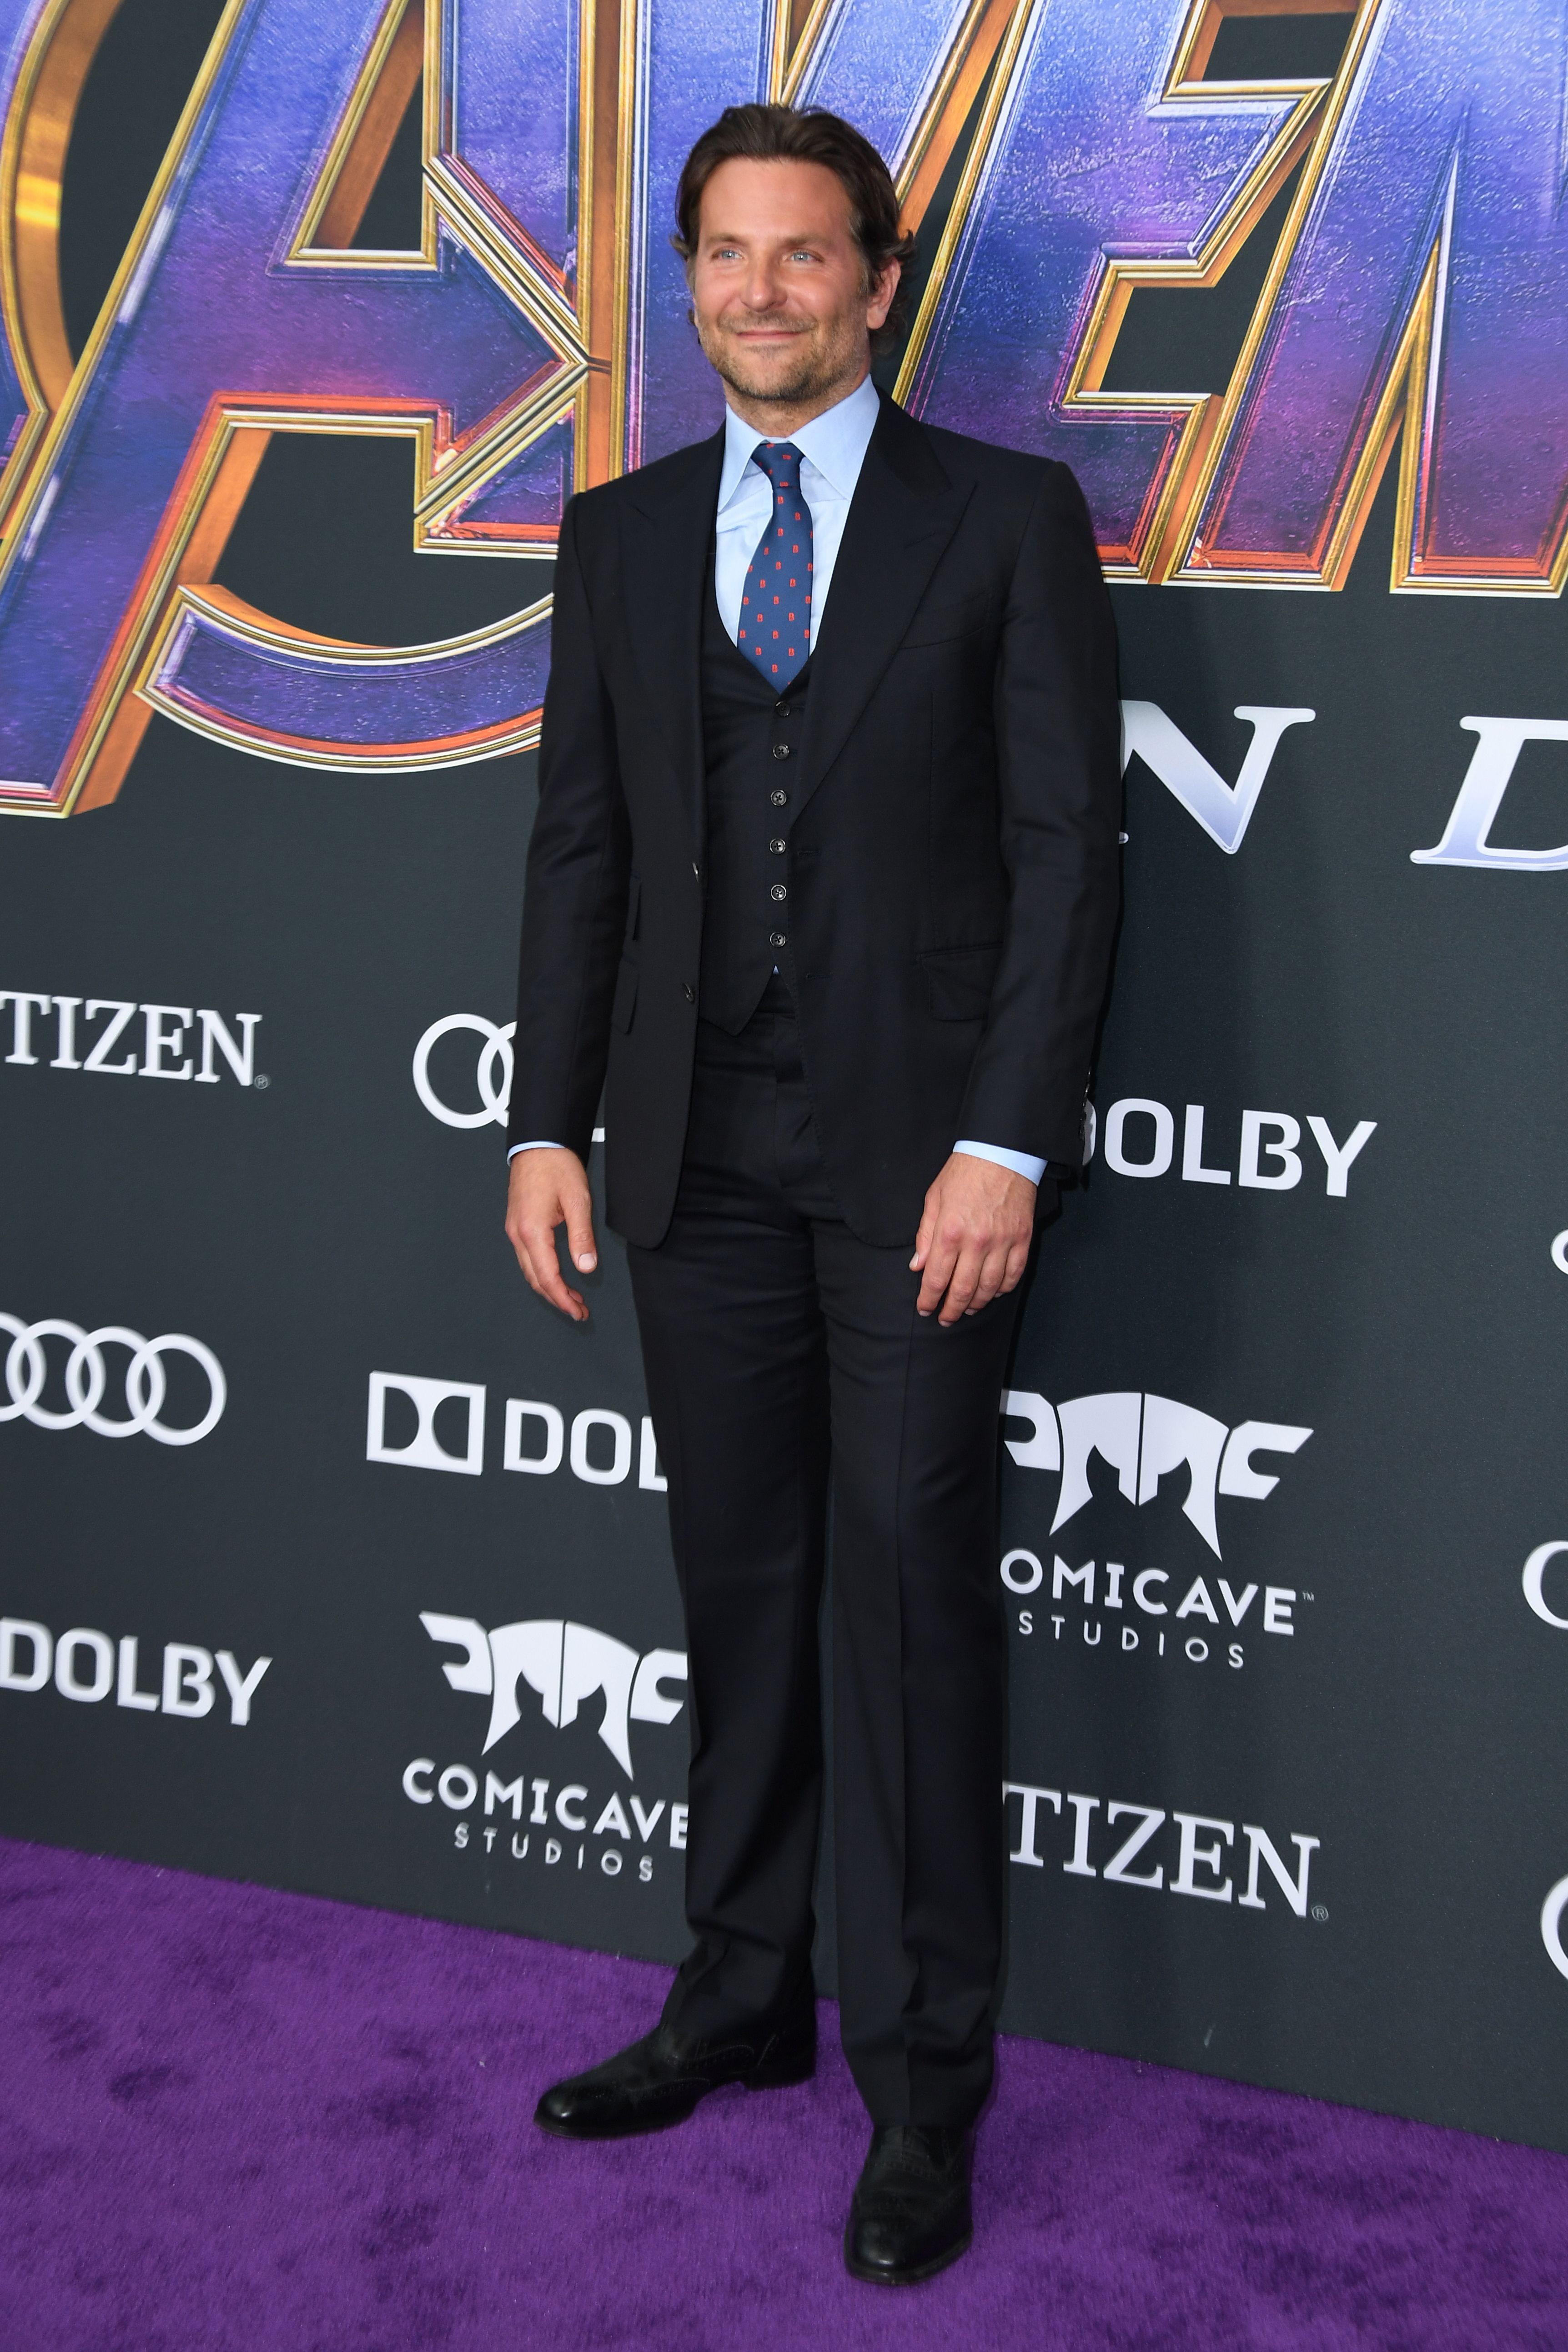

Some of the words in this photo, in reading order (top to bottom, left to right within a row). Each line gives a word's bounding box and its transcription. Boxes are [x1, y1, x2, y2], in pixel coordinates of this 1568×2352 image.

[0, 990, 262, 1087] TIZEN
[1082, 1098, 1377, 1198] OLBY
[503, 1397, 668, 1493] DOL
[0, 1616, 273, 1726] DOLBY
[1019, 1610, 1244, 1669] STUDIOS
[402, 1758, 689, 1850] COMICAVE
[454, 1822, 653, 1882] STUDIOS
[1002, 1781, 1320, 1918] TIZEN
